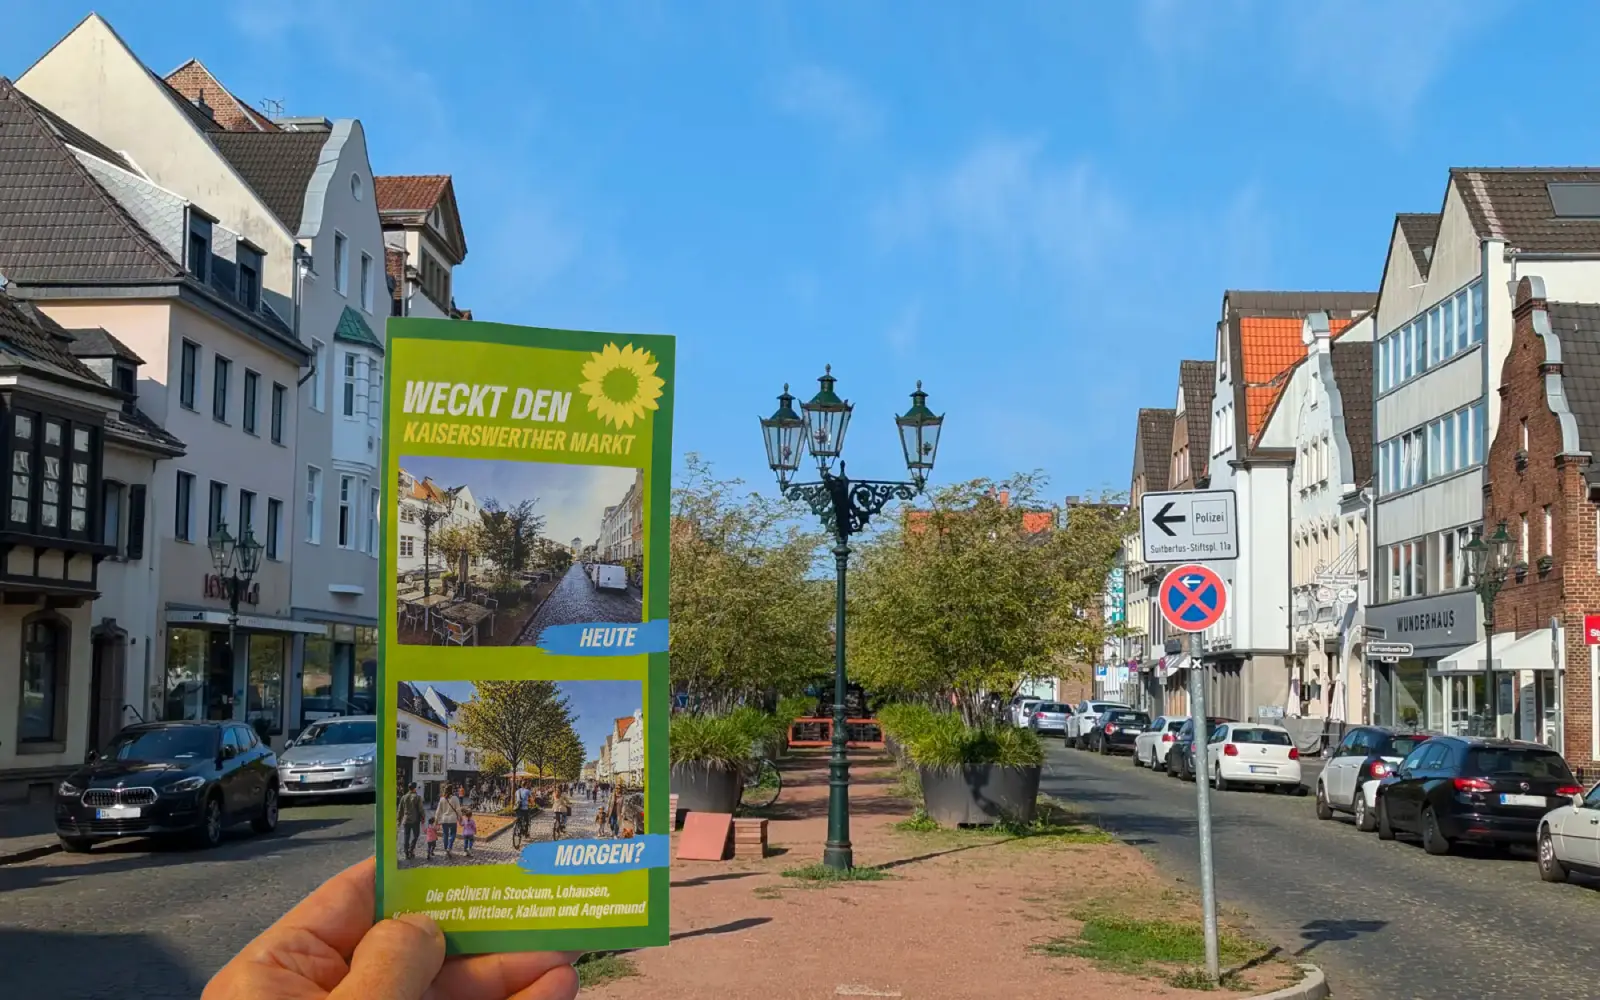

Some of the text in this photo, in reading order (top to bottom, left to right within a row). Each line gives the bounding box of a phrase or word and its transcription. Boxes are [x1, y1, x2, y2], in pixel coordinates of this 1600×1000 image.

[402, 380, 572, 423] WECKT DEN
[403, 421, 636, 455] KAISERSWERTHER MARKT
[1195, 511, 1225, 523] Polizei
[1150, 541, 1232, 554] Suitbertus-Stiftspl. 11a
[1397, 609, 1455, 632] WUNDERHAUS
[580, 627, 637, 648] HEUTE
[554, 842, 645, 867] MORGEN?
[425, 884, 610, 903] Die GRÜNEN in Stockum, Lohausen,
[468, 905, 514, 920] Wittlaer,
[516, 903, 556, 919] Kalkum
[558, 903, 579, 917] und
[581, 900, 647, 919] Angermund
